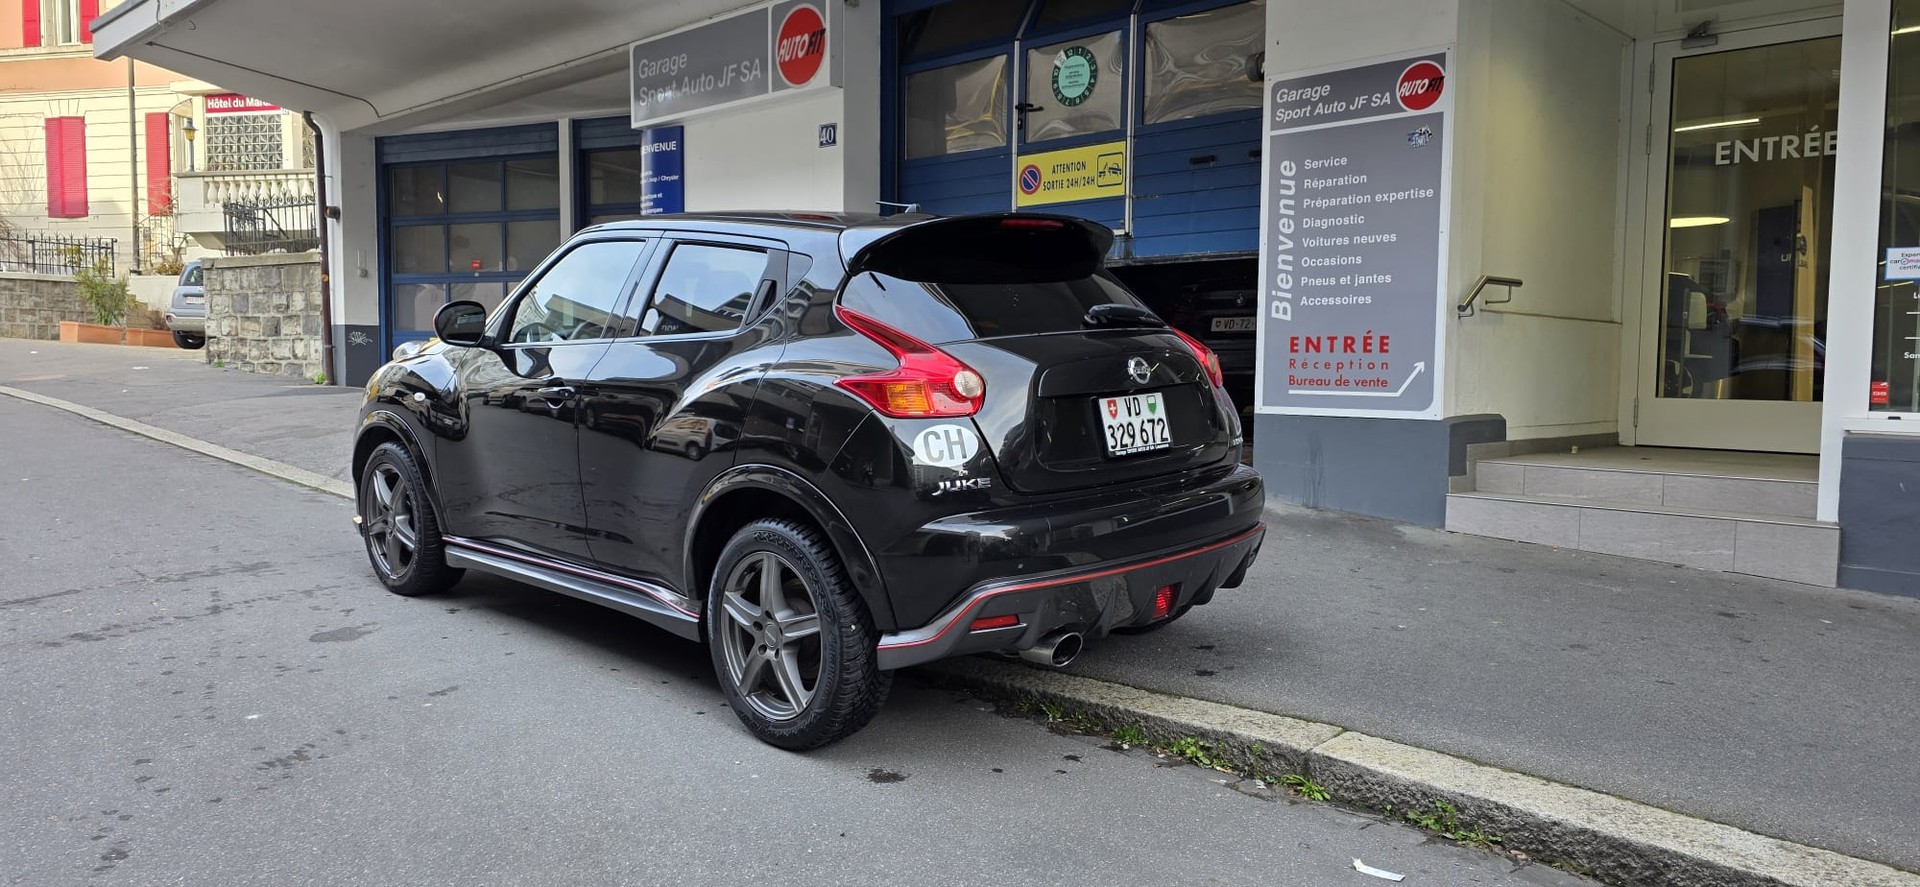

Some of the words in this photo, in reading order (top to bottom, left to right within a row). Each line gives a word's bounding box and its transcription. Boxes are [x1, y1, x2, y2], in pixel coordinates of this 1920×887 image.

[778, 28, 826, 62] AUTOFIT
[639, 53, 687, 78] Garage
[640, 80, 676, 106] Sport
[681, 74, 714, 94] Auto
[718, 64, 737, 88] JF
[740, 59, 761, 82] SA
[1400, 76, 1445, 97] AUTOFIT
[1276, 84, 1330, 103] Garage
[208, 98, 230, 108] Hôtel
[232, 98, 244, 107] du
[1276, 108, 1312, 122] Sport
[1314, 102, 1346, 116] Auto
[1350, 96, 1368, 110] JF
[1371, 92, 1391, 106] SA
[821, 128, 834, 143] 40
[1715, 124, 1837, 165] ENTRÉE
[1052, 161, 1086, 174] ATTENTION
[1304, 156, 1348, 169] Service
[1043, 180, 1064, 191] SORTIE
[1066, 176, 1095, 189] 24H/24H
[1304, 174, 1367, 190] Réparation
[1304, 193, 1371, 209] Préparation
[1376, 188, 1434, 202] expertise
[1302, 214, 1365, 230] Diagnostic
[1271, 160, 1296, 322] Bienvenue
[1302, 236, 1350, 248] Voitures
[1354, 233, 1397, 244] neuves
[1302, 255, 1362, 267] Occasions
[1301, 276, 1336, 286] Pneus
[1340, 275, 1350, 285] et
[1354, 273, 1392, 286] jantes
[1300, 294, 1372, 306] Accessoires
[1290, 330, 1390, 354] ENTRÉE
[1289, 358, 1388, 372] Réception
[1288, 374, 1330, 386] Bureau
[1334, 375, 1350, 386] de
[1354, 377, 1388, 388] vente
[1124, 397, 1141, 418] VD
[1108, 422, 1135, 450] 329
[1140, 418, 1168, 445] 672
[923, 429, 967, 463] CH
[931, 478, 991, 496] JUKE
